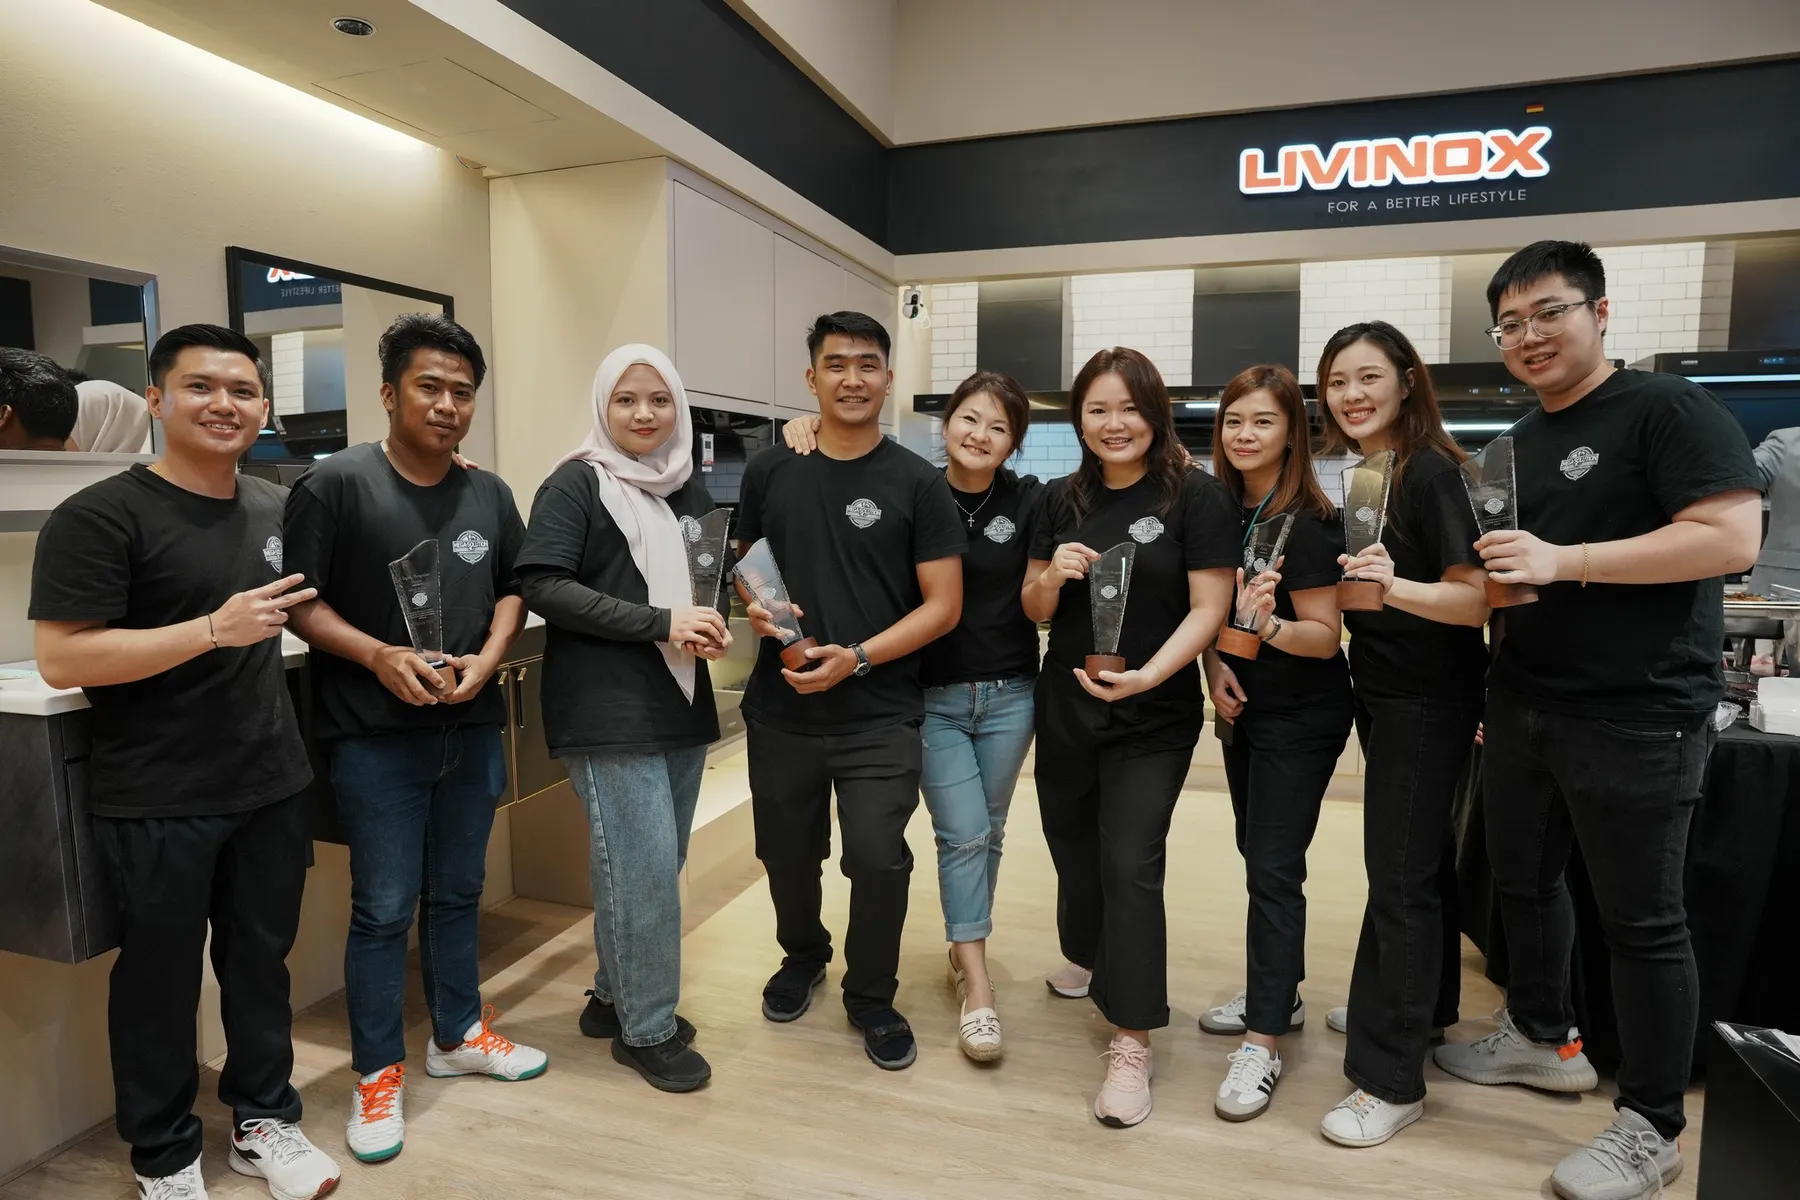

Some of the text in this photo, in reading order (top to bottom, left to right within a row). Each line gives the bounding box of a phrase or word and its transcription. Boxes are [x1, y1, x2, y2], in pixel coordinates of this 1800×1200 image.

[1242, 129, 1550, 192] LIVINOX
[1327, 189, 1527, 213] FOR A BETTER LIFESTYLE
